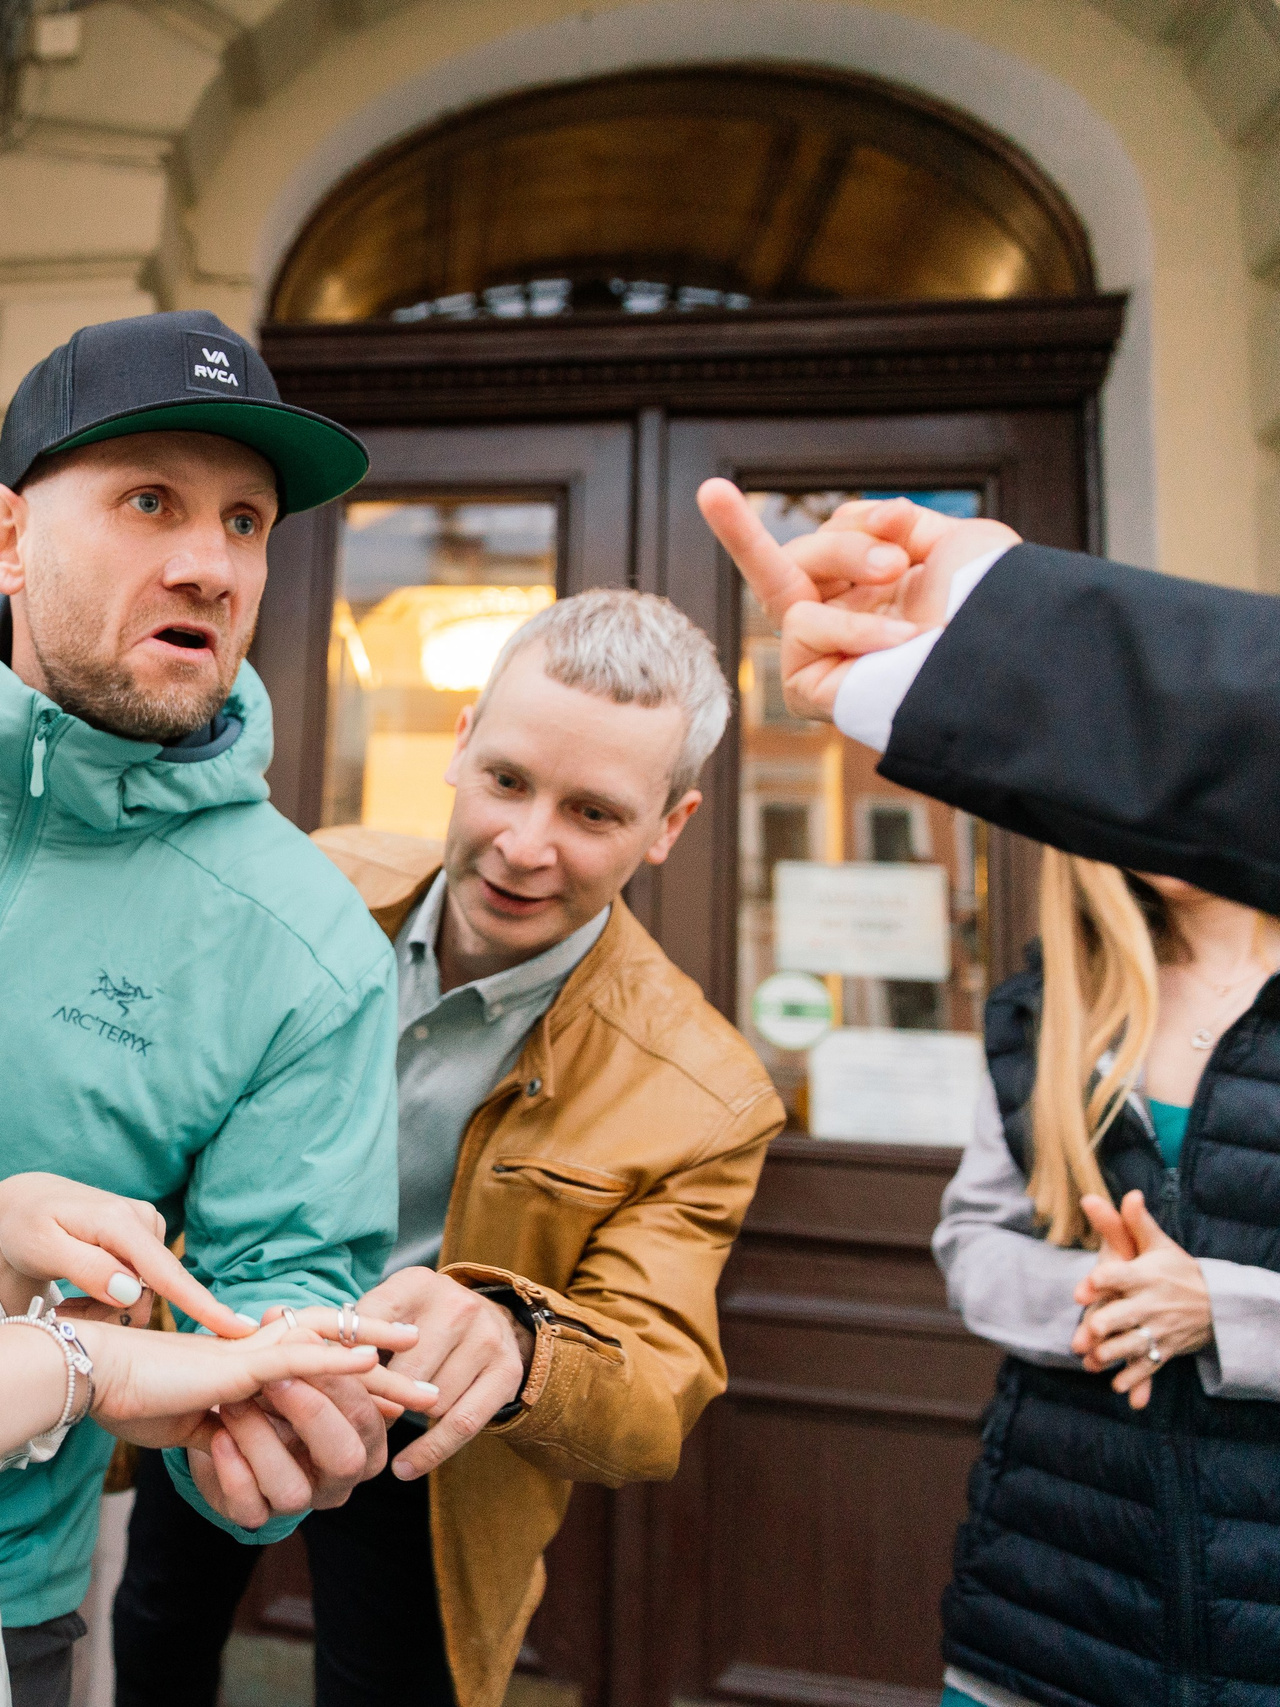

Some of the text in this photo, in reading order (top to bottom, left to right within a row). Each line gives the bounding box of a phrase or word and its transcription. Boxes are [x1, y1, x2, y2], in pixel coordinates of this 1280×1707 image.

[201, 347, 230, 368] VA
[194, 364, 239, 387] RVCA
[52, 1005, 154, 1057] ARC'TERYX
